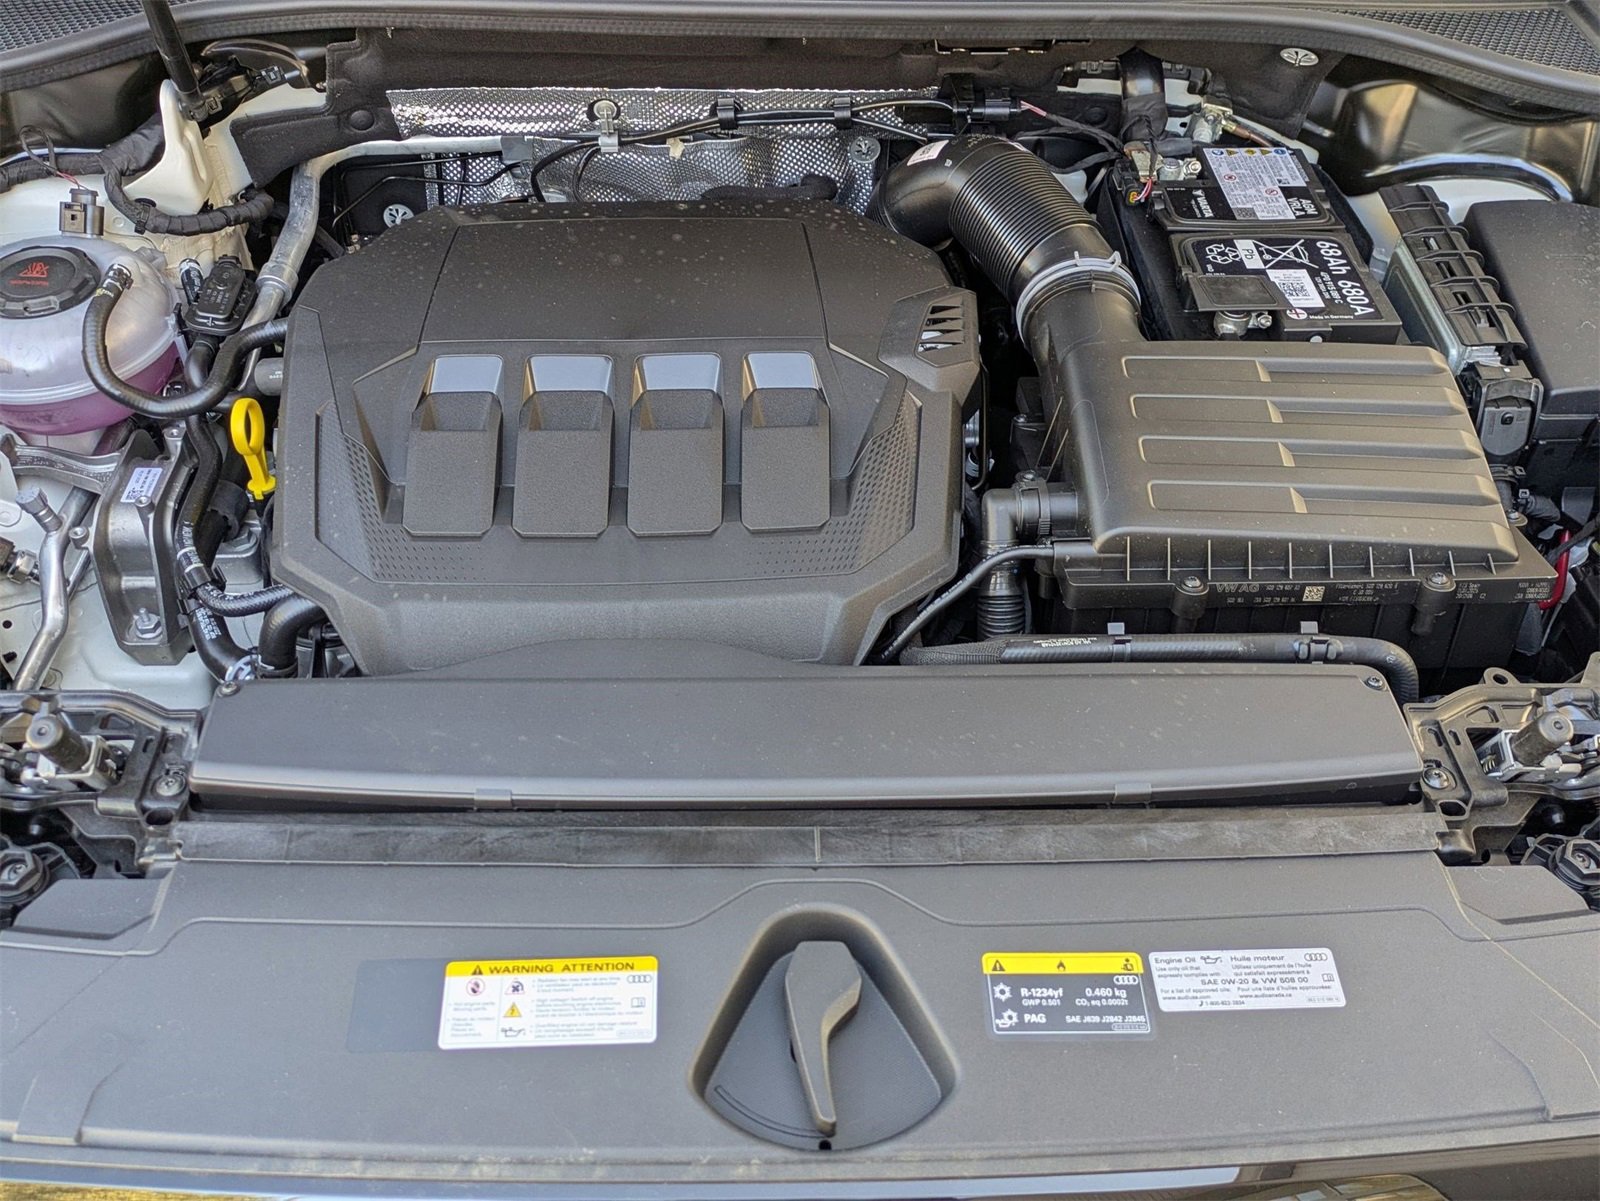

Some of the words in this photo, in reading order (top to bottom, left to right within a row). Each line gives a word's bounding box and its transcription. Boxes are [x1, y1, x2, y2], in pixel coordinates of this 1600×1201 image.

[1197, 197, 1215, 218] VARTA
[1287, 197, 1306, 216] VRLA
[1241, 248, 1254, 260] Pb
[1315, 240, 1351, 275] 68Ah
[1337, 280, 1375, 316] 680A
[1216, 584, 1238, 592] VW
[1239, 584, 1260, 592] AG
[489, 964, 554, 974] WARNING
[561, 962, 634, 972] ATTENTION
[1020, 988, 1063, 998] R-1234yf
[1085, 988, 1112, 997] 0.460
[1114, 988, 1126, 998] kg
[1024, 1014, 1046, 1023] PAG
